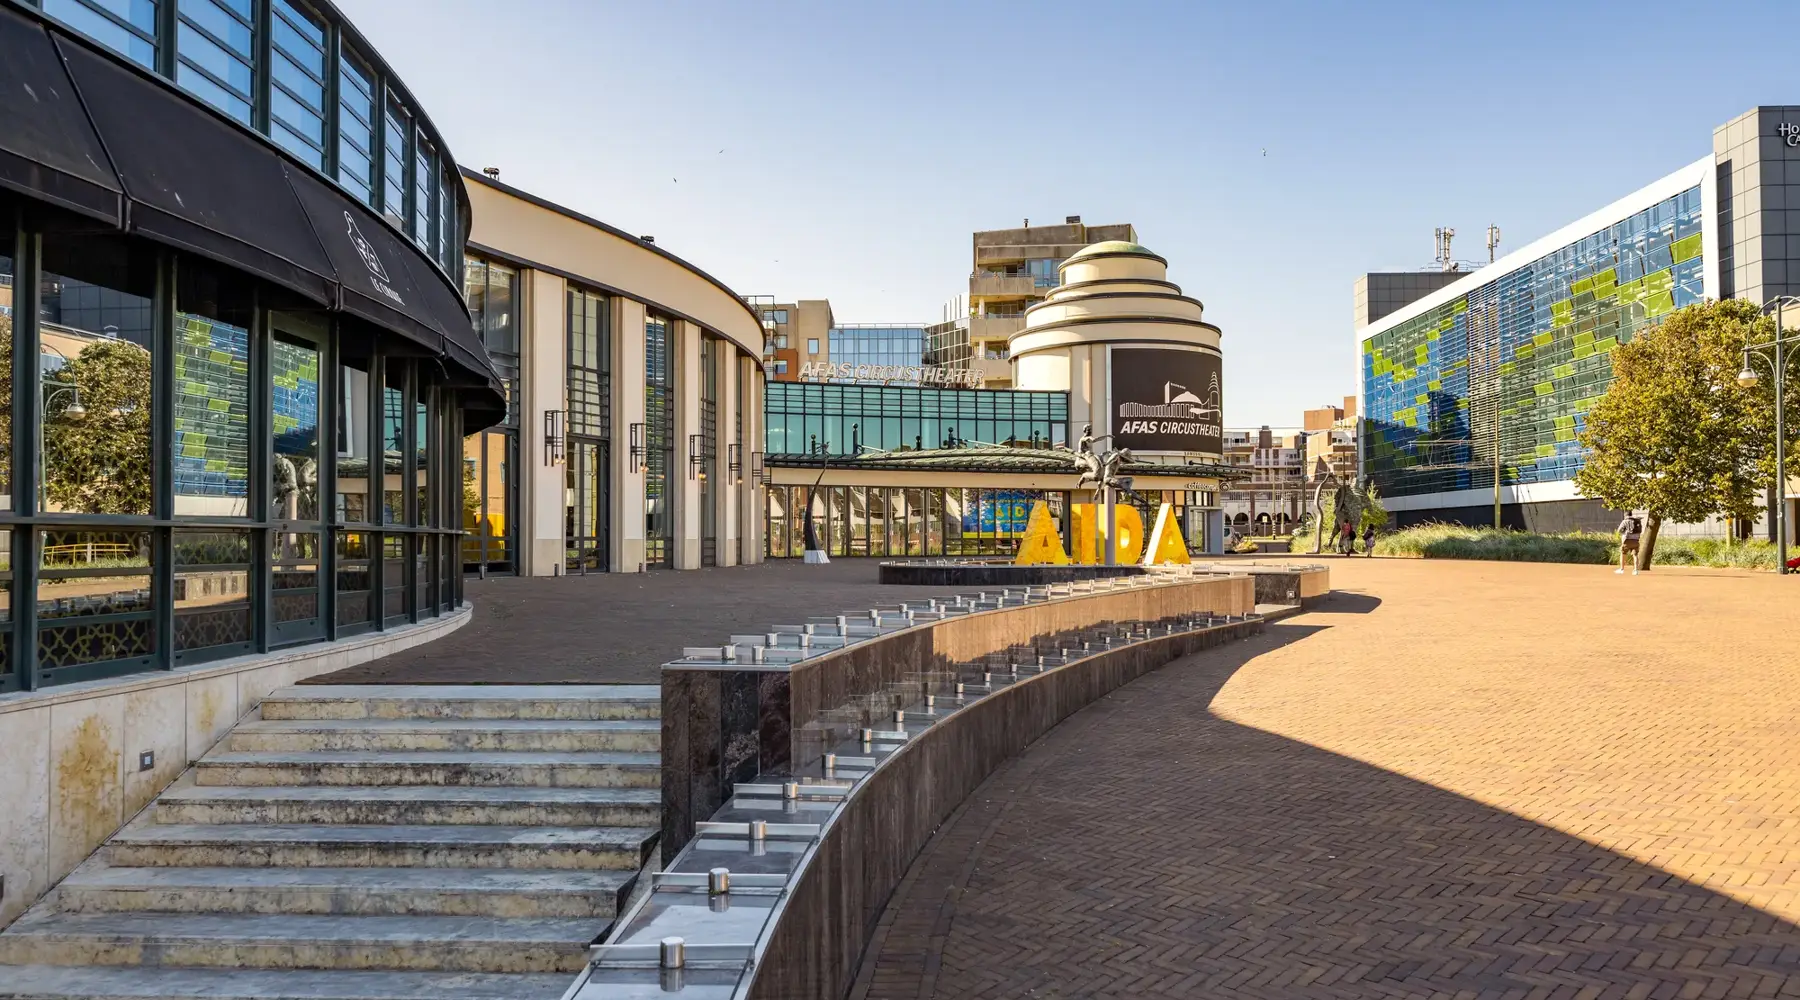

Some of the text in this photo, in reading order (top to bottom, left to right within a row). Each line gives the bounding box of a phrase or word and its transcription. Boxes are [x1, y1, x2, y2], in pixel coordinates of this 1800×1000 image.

[798, 361, 985, 384] AFAS CIRCUSTHEATER
[1120, 421, 1220, 438] AFAS CIRCUSTHEATER
[1014, 500, 1192, 565] AIDA
